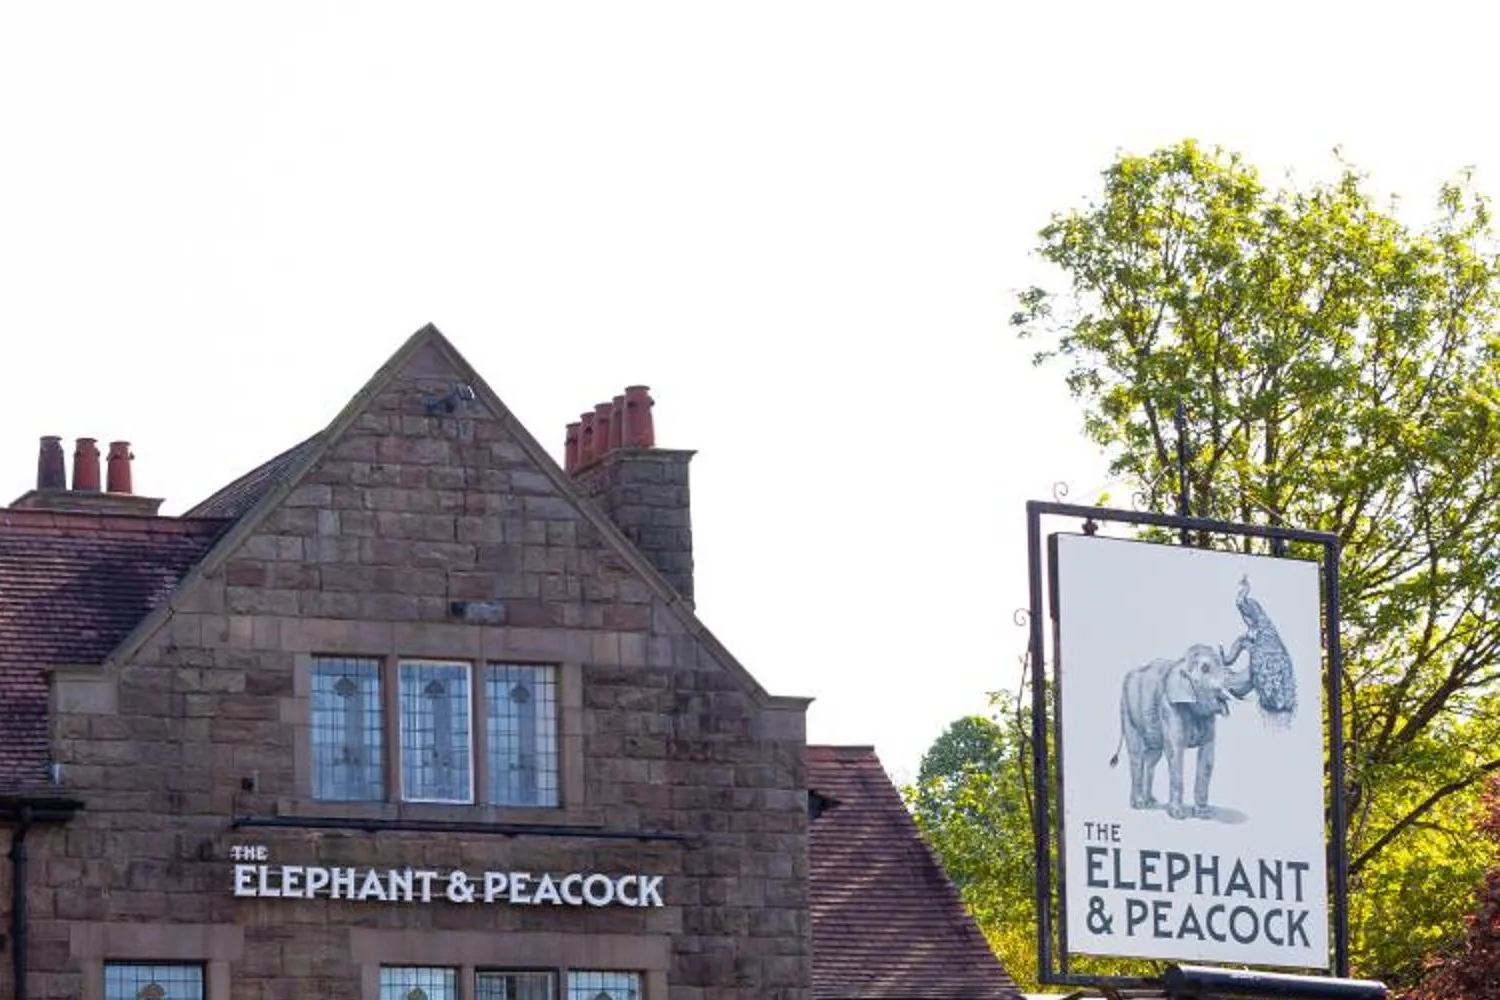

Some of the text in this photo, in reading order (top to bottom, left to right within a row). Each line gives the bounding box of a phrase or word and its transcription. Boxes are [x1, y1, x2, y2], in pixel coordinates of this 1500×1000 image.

[232, 845, 268, 861] THE
[1084, 821, 1121, 842] THE
[234, 864, 665, 907] ELEPHANT & PEACOCK
[1085, 846, 1310, 901] ELEPHANT
[1086, 896, 1311, 948] & PEACOCK
